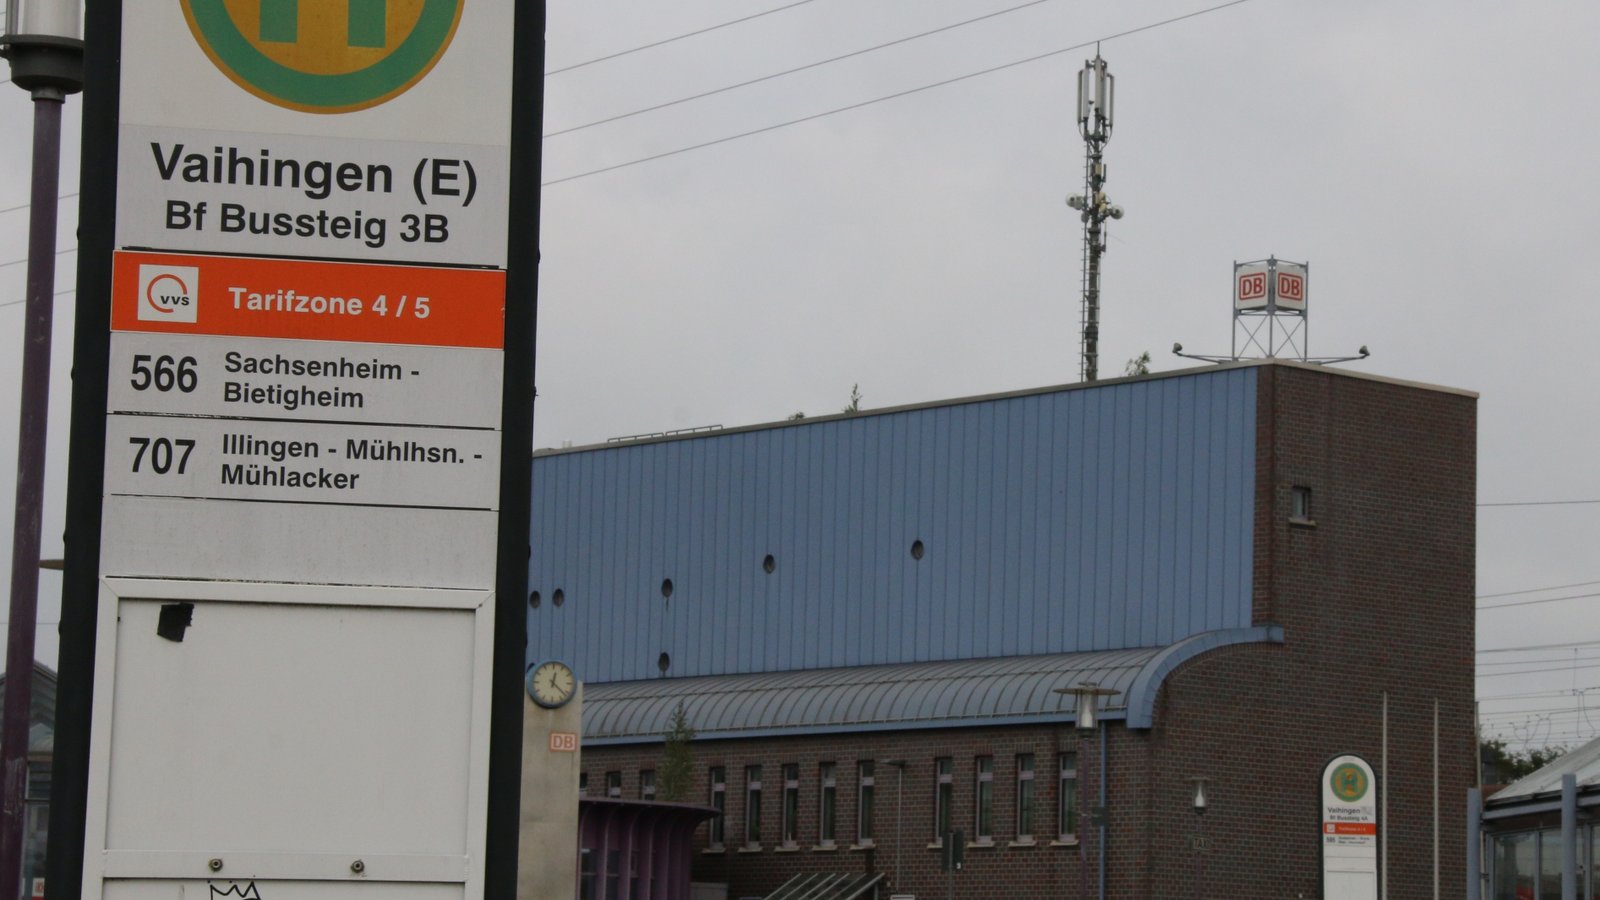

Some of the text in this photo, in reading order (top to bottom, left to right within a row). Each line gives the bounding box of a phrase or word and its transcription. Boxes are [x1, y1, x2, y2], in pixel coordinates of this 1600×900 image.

[150, 141, 477, 208] Vaihingen (E)
[165, 199, 449, 249] Bf Bussteig 3B
[1242, 276, 1263, 297] DB
[1280, 276, 1301, 297] DB
[228, 286, 430, 319] Tarifzone 4 / 5
[130, 354, 198, 394] 566
[224, 351, 402, 380] Sachsenheim
[223, 381, 364, 411] Bietigheim
[129, 436, 196, 475] 707
[222, 433, 319, 463] Illingen
[346, 438, 464, 464] Mühlhsn.
[221, 463, 360, 490] Mühlacker
[553, 735, 573, 749] DB
[1327, 807, 1361, 815] Vaihingen
